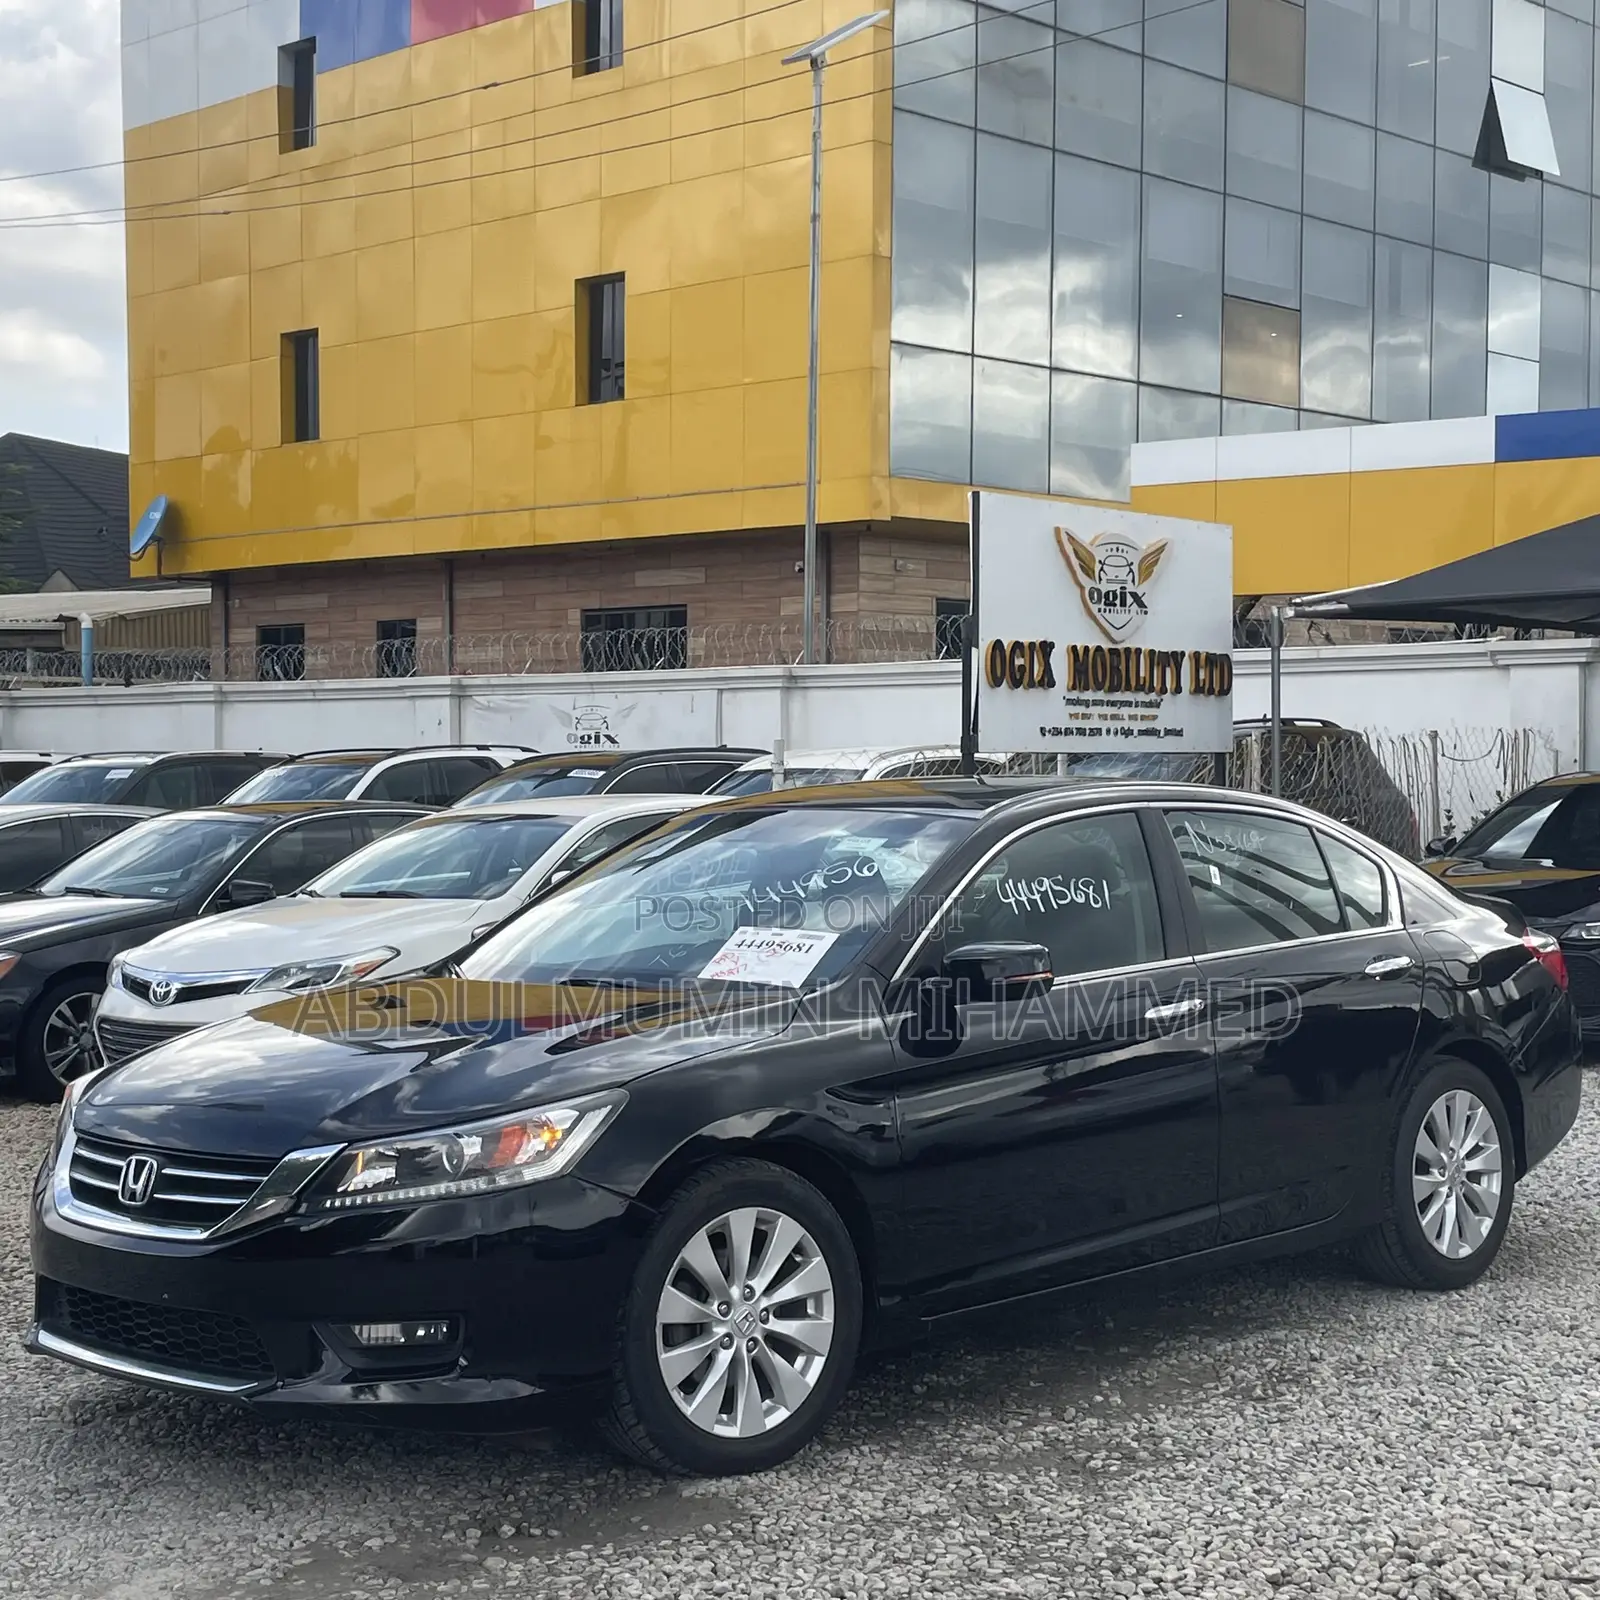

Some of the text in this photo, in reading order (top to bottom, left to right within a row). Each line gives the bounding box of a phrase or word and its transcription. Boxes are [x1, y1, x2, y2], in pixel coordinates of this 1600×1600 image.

[985, 638, 1233, 697] OGIX MOBILITY LTD
[996, 874, 1112, 914] 44495681
[734, 939, 815, 954] 44495681
